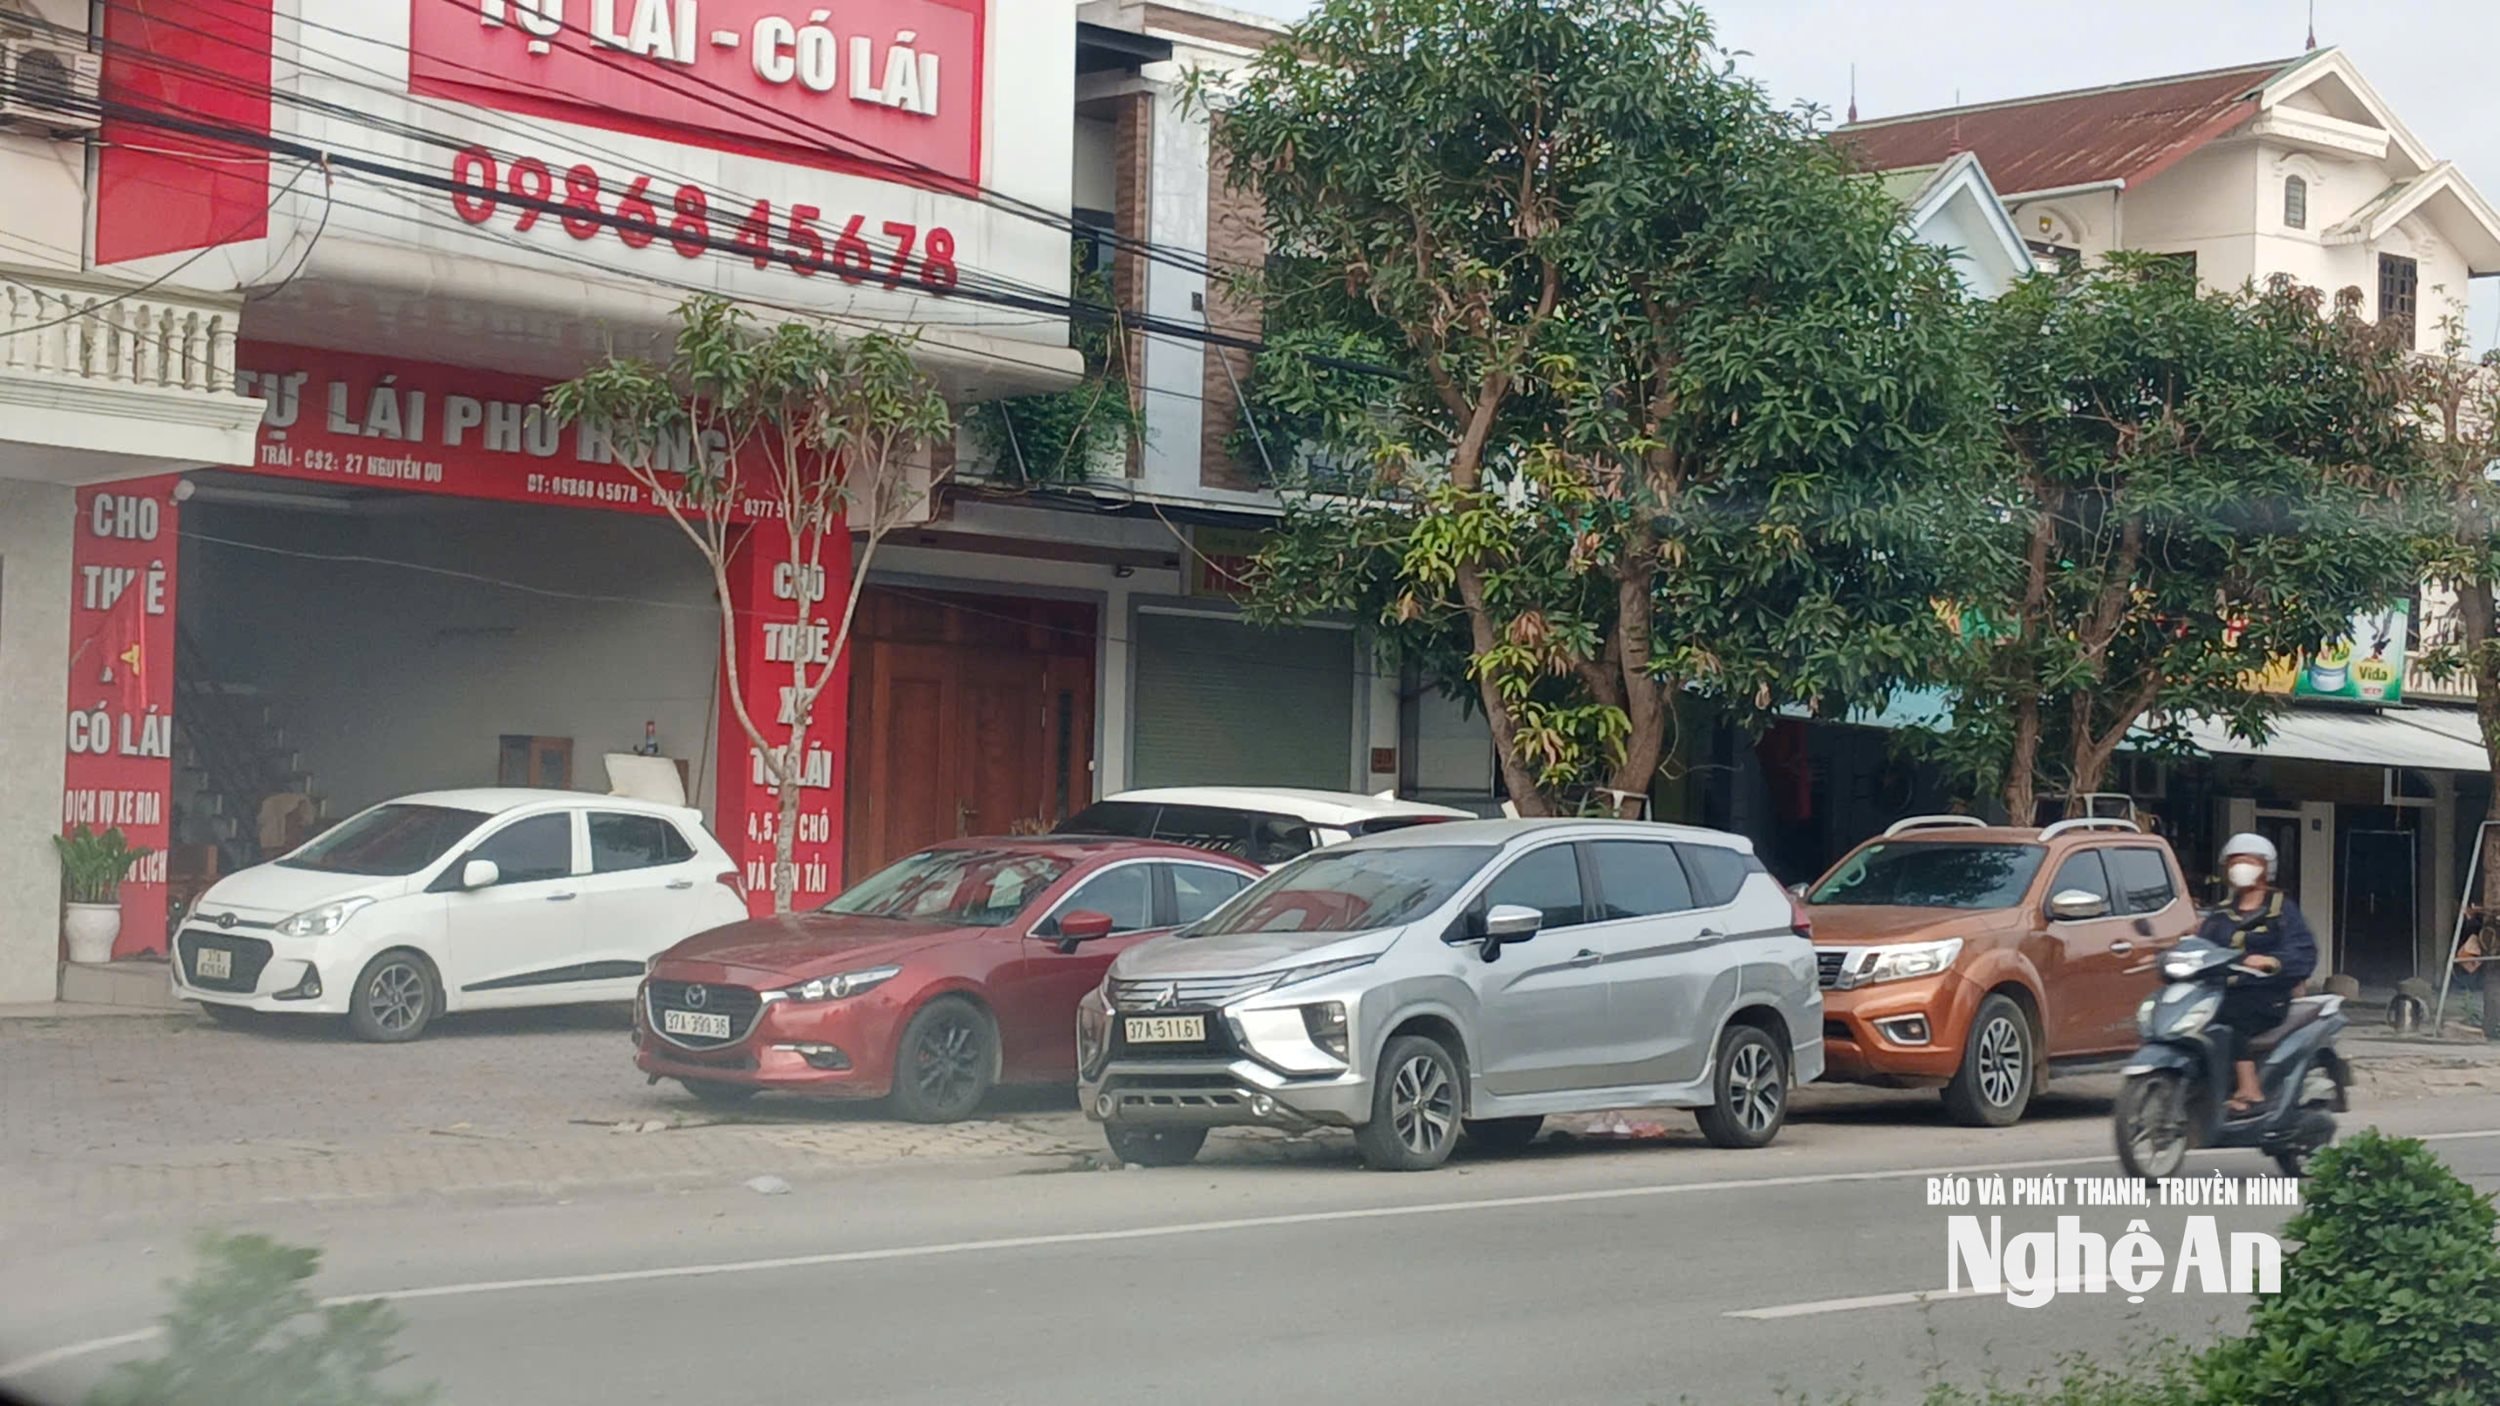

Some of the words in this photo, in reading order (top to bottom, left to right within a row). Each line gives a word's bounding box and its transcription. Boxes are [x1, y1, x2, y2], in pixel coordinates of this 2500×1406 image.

[711, 28, 739, 48] -
[752, 8, 837, 92] CÓ
[848, 29, 941, 118] LÁI
[326, 374, 427, 443] LÁI
[304, 449, 339, 472] CS2:
[345, 453, 363, 474] 27
[91, 492, 160, 541] CHO
[2358, 666, 2388, 682] Vida
[68, 700, 112, 755] CÓ
[119, 703, 172, 759] LÁI
[65, 789, 96, 828] DỊCH
[99, 789, 115, 829] VỤ
[117, 789, 135, 824] XE
[136, 791, 160, 825] HOA
[748, 811, 783, 845] 4,5,
[124, 858, 138, 882] U
[140, 848, 168, 890] LỊCH
[747, 854, 766, 891] VÀ
[770, 861, 800, 892] BN
